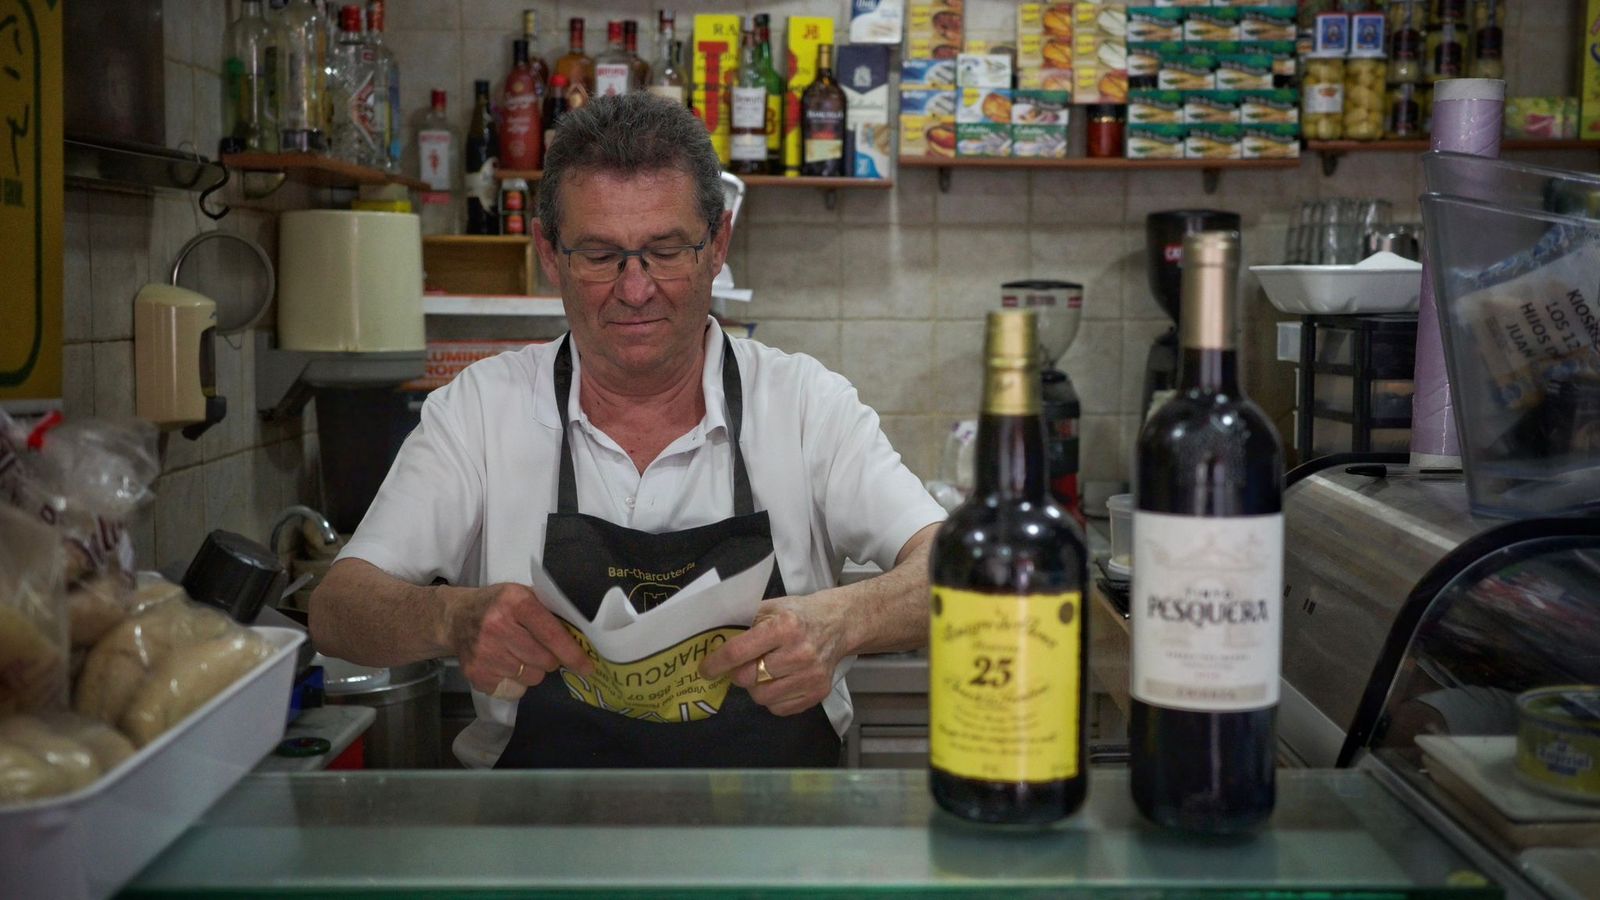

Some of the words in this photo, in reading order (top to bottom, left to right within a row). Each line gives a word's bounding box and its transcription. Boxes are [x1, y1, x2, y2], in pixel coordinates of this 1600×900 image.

[1521, 302, 1551, 345] HIJOS
[1505, 322, 1537, 359] JUAN
[1147, 595, 1269, 627] PESQUERA
[969, 655, 1013, 688] 25
[676, 685, 706, 697] Virgen
